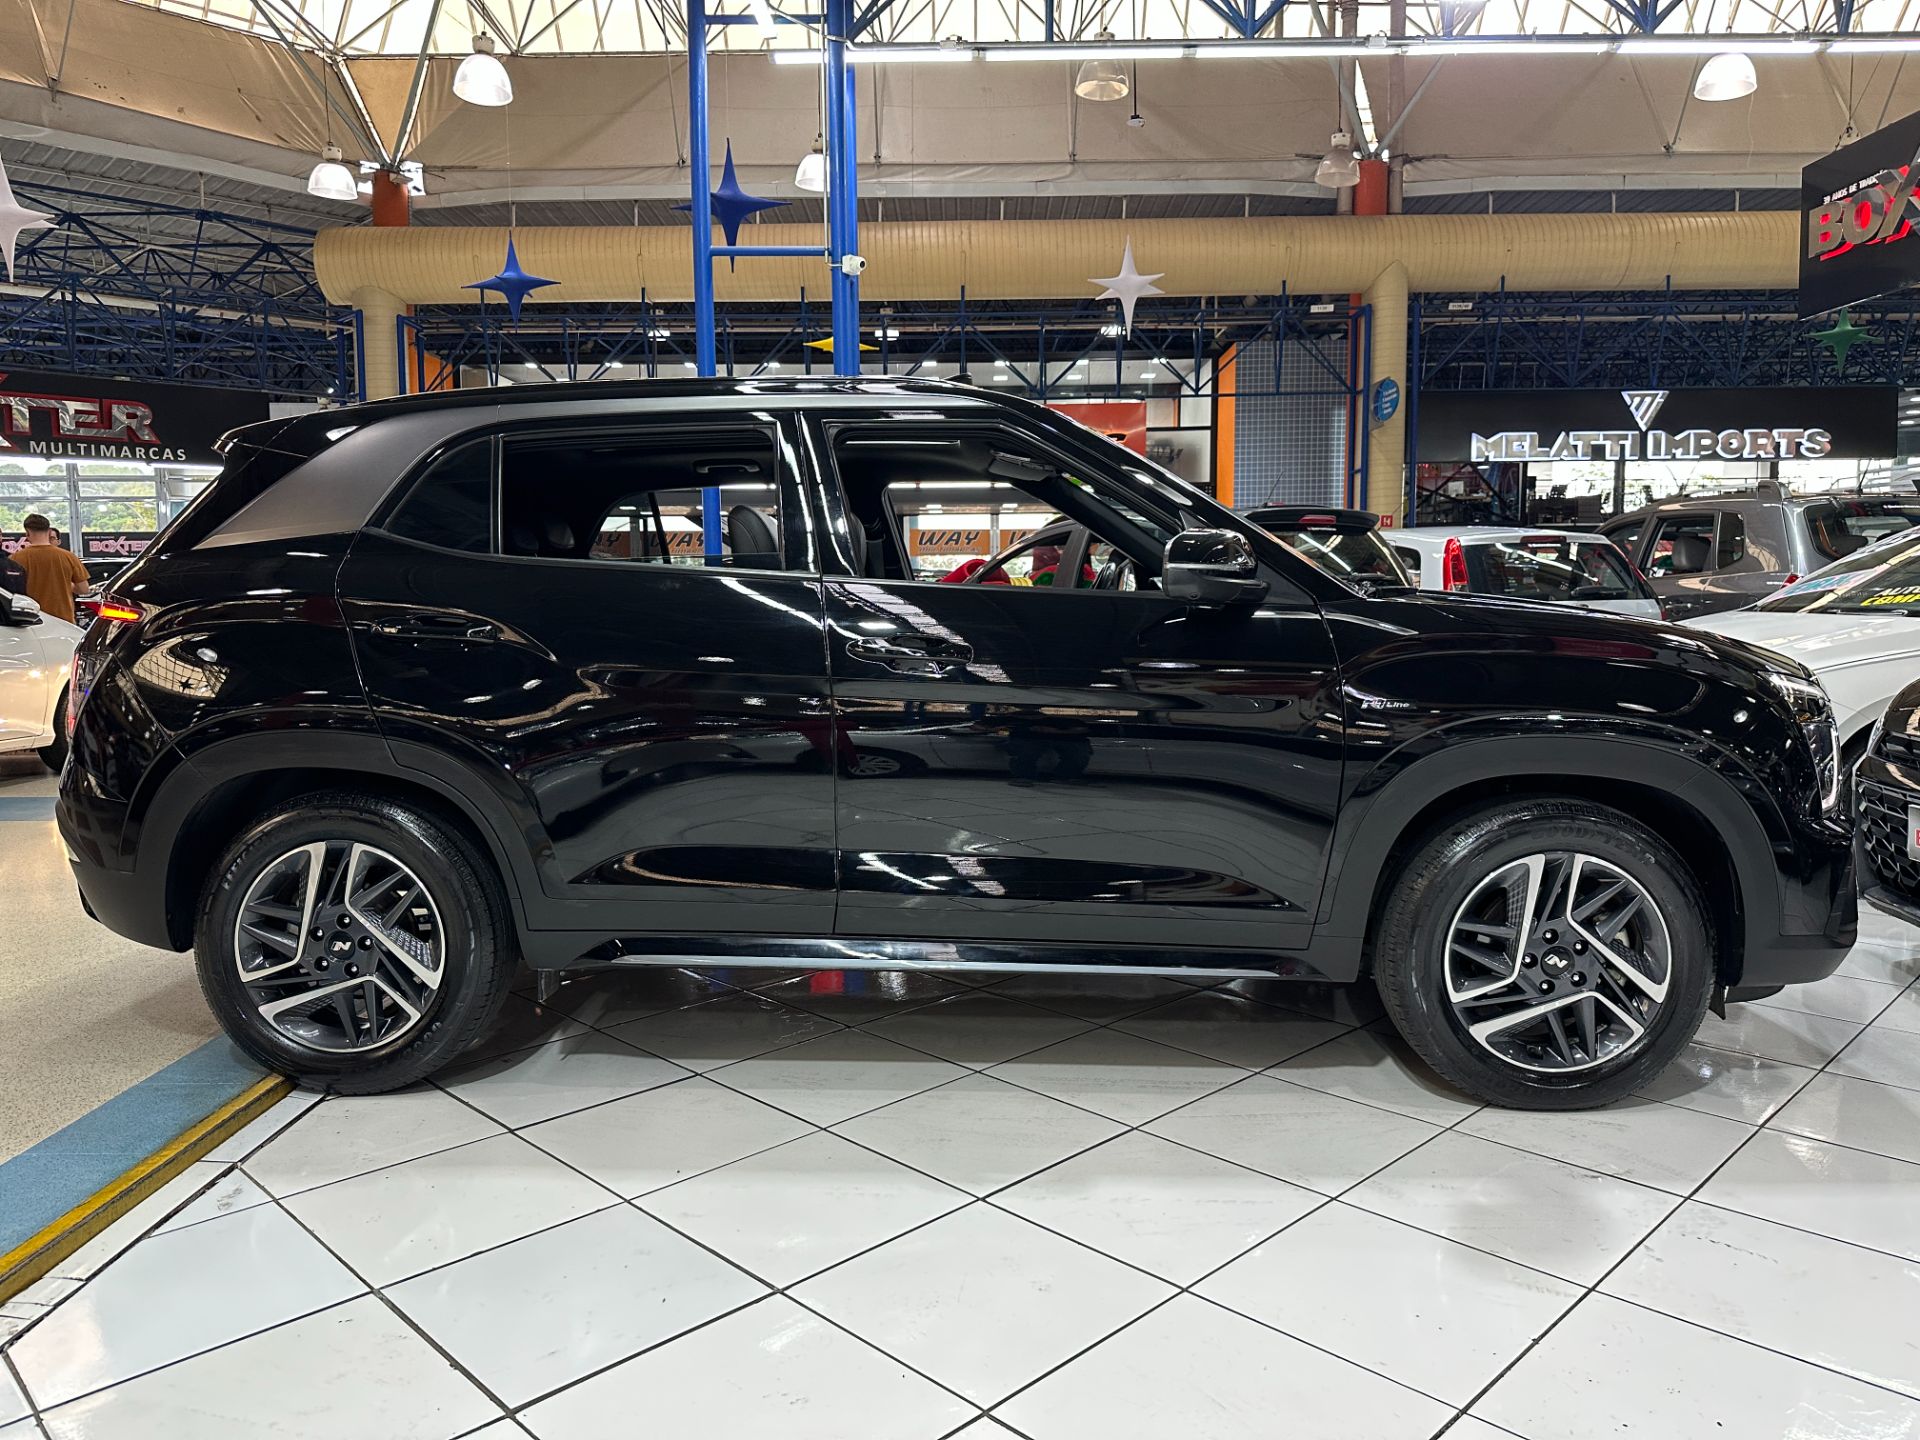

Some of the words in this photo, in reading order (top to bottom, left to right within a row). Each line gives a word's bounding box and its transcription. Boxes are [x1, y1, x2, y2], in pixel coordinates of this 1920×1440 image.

[1848, 182, 1858, 194] DE
[0, 387, 161, 449] TER
[29, 440, 188, 462] MULTIMARCAS
[1471, 430, 1641, 462] MELATTI
[1647, 428, 1833, 460] IMPORTS
[919, 531, 981, 546] WAY
